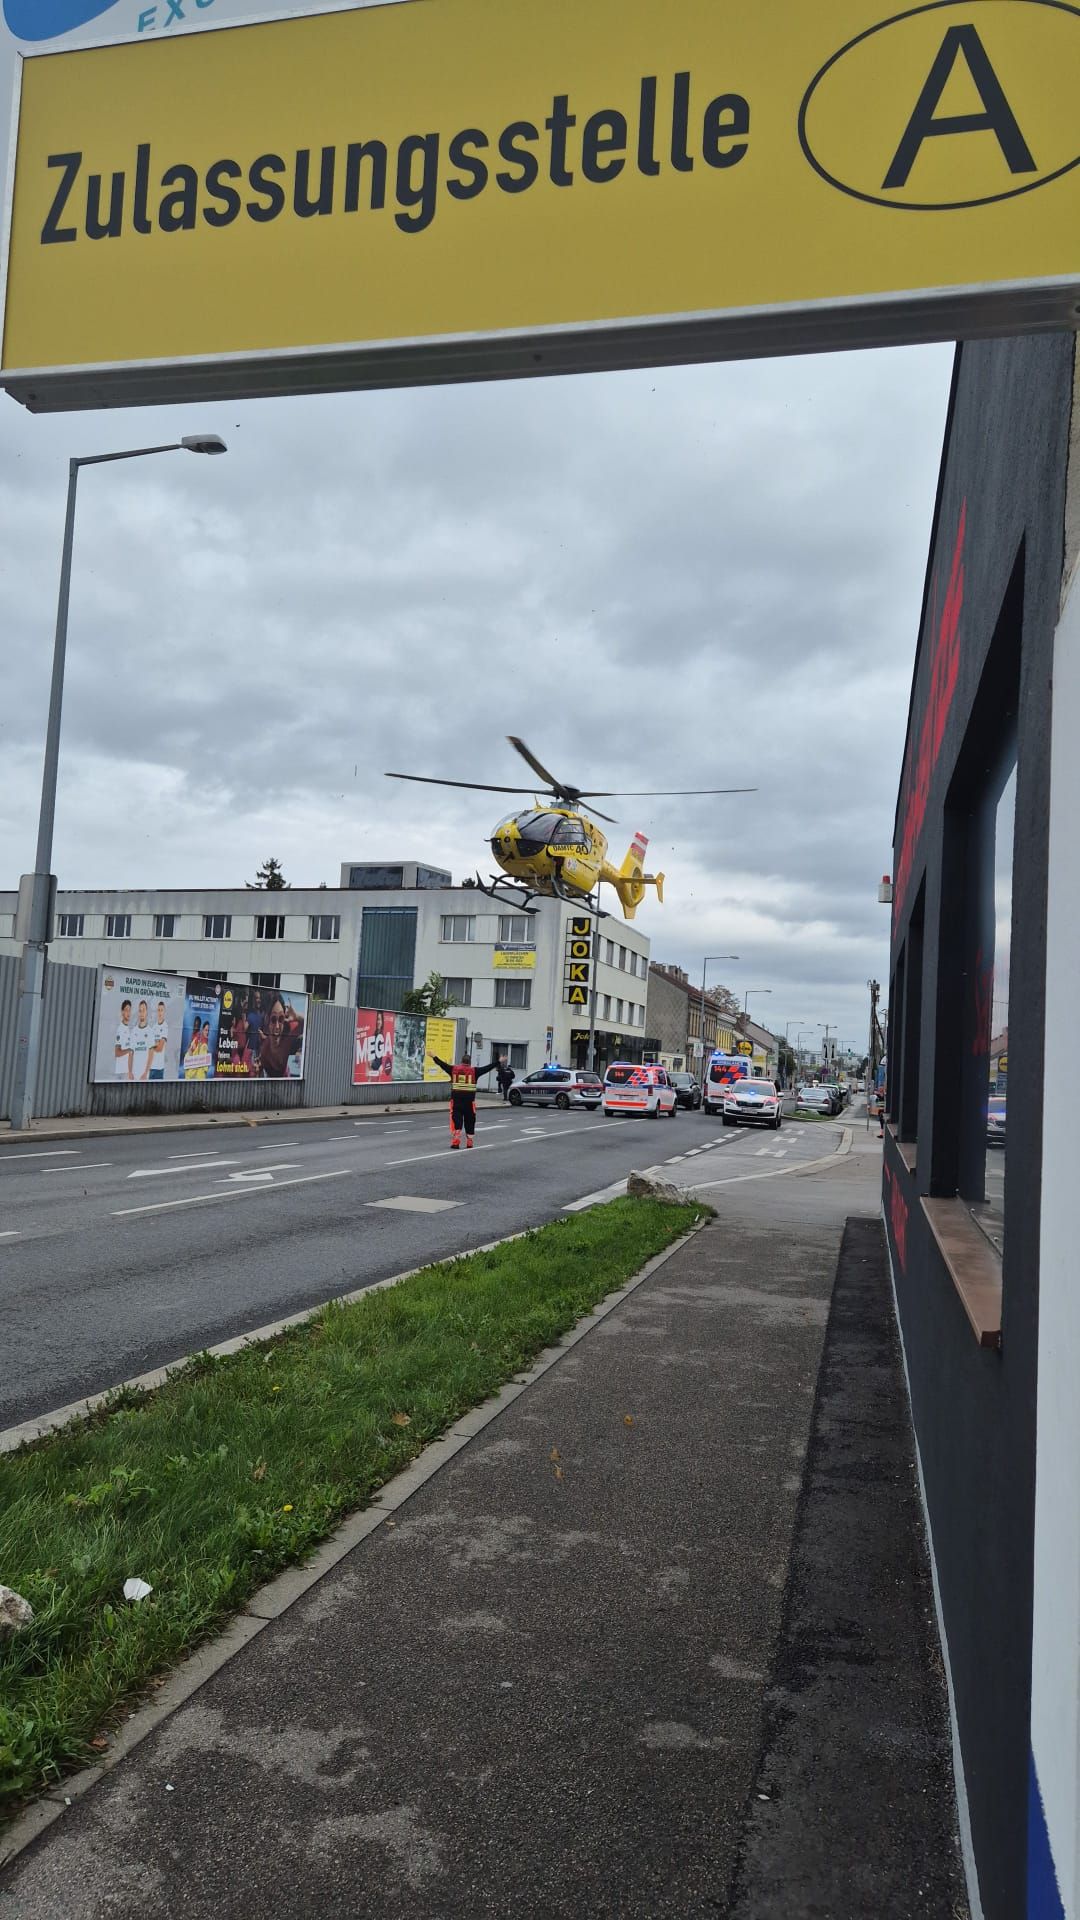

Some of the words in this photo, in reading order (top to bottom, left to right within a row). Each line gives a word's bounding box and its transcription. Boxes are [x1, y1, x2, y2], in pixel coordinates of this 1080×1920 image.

[41, 70, 751, 245] Zulassungsstelle
[881, 23, 1038, 190] A
[576, 845, 589, 855] 40
[569, 919, 590, 1003] JOKA
[126, 977, 141, 986] RAPID
[120, 986, 133, 994] WIEN
[574, 1032, 594, 1041] Jok
[219, 1037, 238, 1049] Leben
[356, 1031, 393, 1065] MEGA
[713, 1065, 727, 1073] 144
